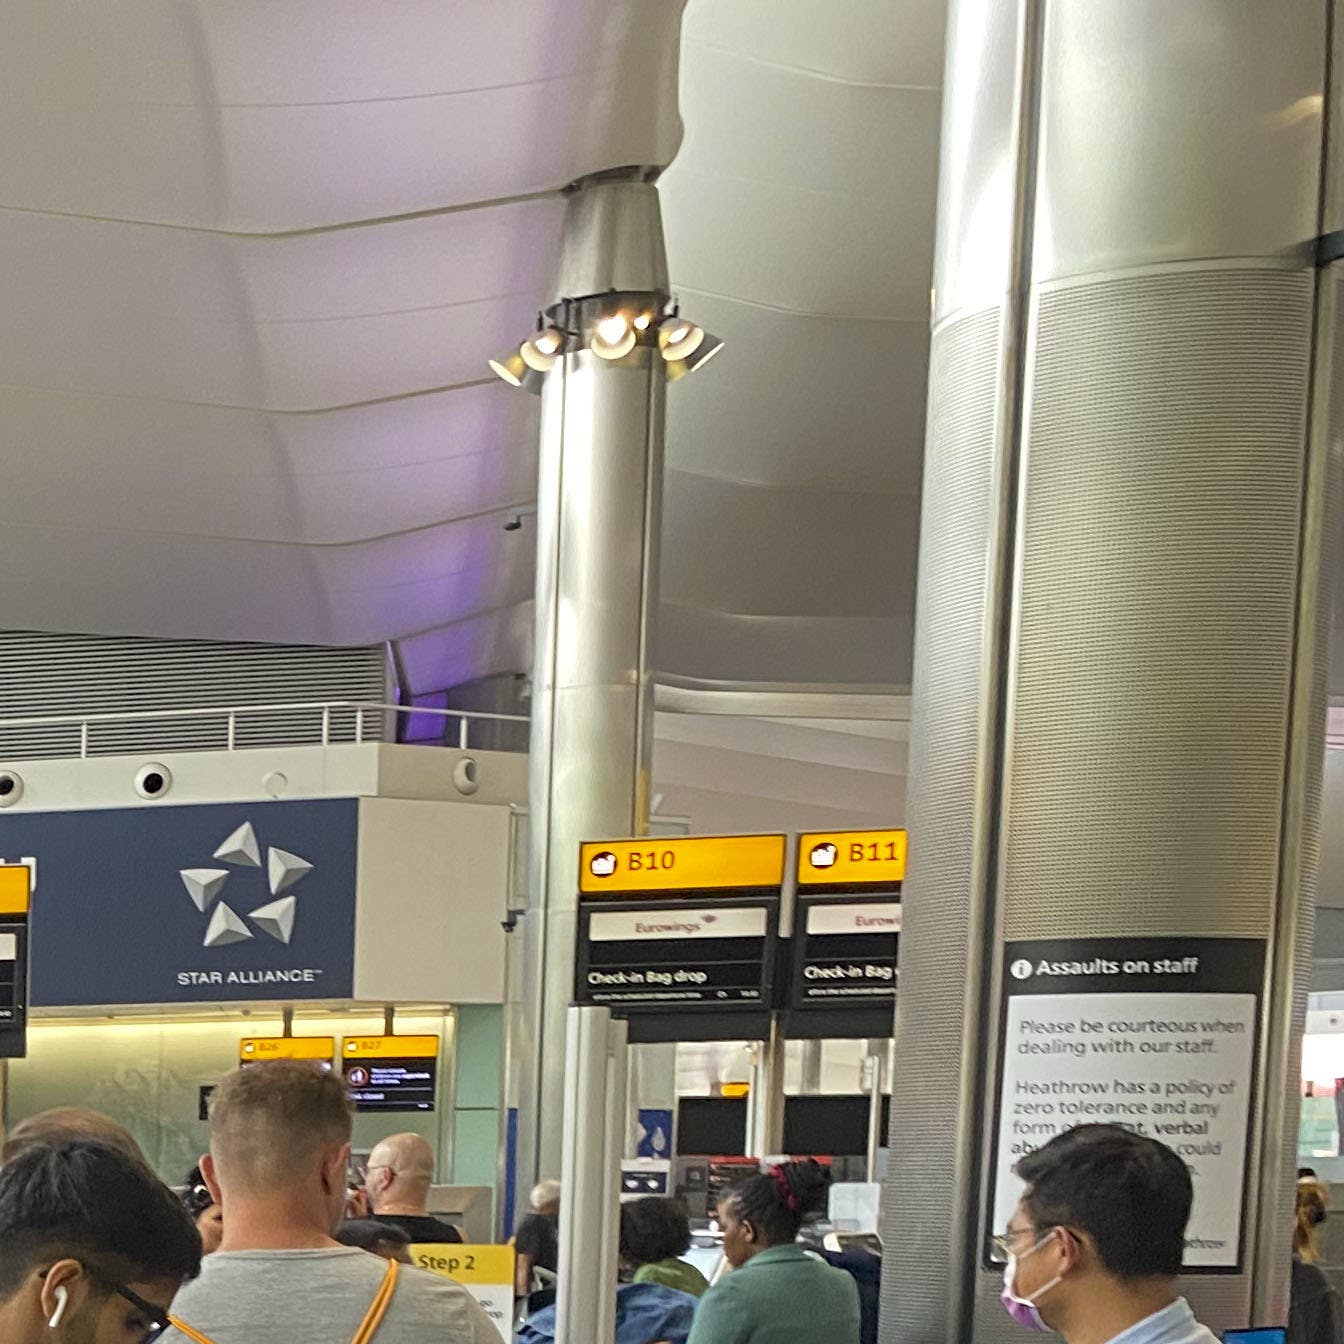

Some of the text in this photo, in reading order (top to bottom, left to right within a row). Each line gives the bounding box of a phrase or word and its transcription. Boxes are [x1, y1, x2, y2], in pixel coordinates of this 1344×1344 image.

[849, 841, 899, 862] B11
[628, 851, 675, 871] B10
[635, 921, 701, 934] Eurowings
[803, 965, 892, 981] Check-in Bag
[1036, 956, 1200, 976] Assaults on staff
[177, 972, 222, 985] STAR
[587, 970, 708, 986] Check-in Bag drop
[1020, 1018, 1245, 1034] Please be courteous when
[1018, 1039, 1086, 1058] dealing
[1091, 1038, 1136, 1055] with
[1139, 1041, 1174, 1053] our
[1015, 1079, 1236, 1100] Heathrow has a policy of
[1013, 1099, 1220, 1119] zero tolerance and any
[1013, 1121, 1056, 1135] form
[1154, 1120, 1209, 1135] verbal
[1177, 1141, 1223, 1156] could
[418, 1254, 475, 1274] Step 2
